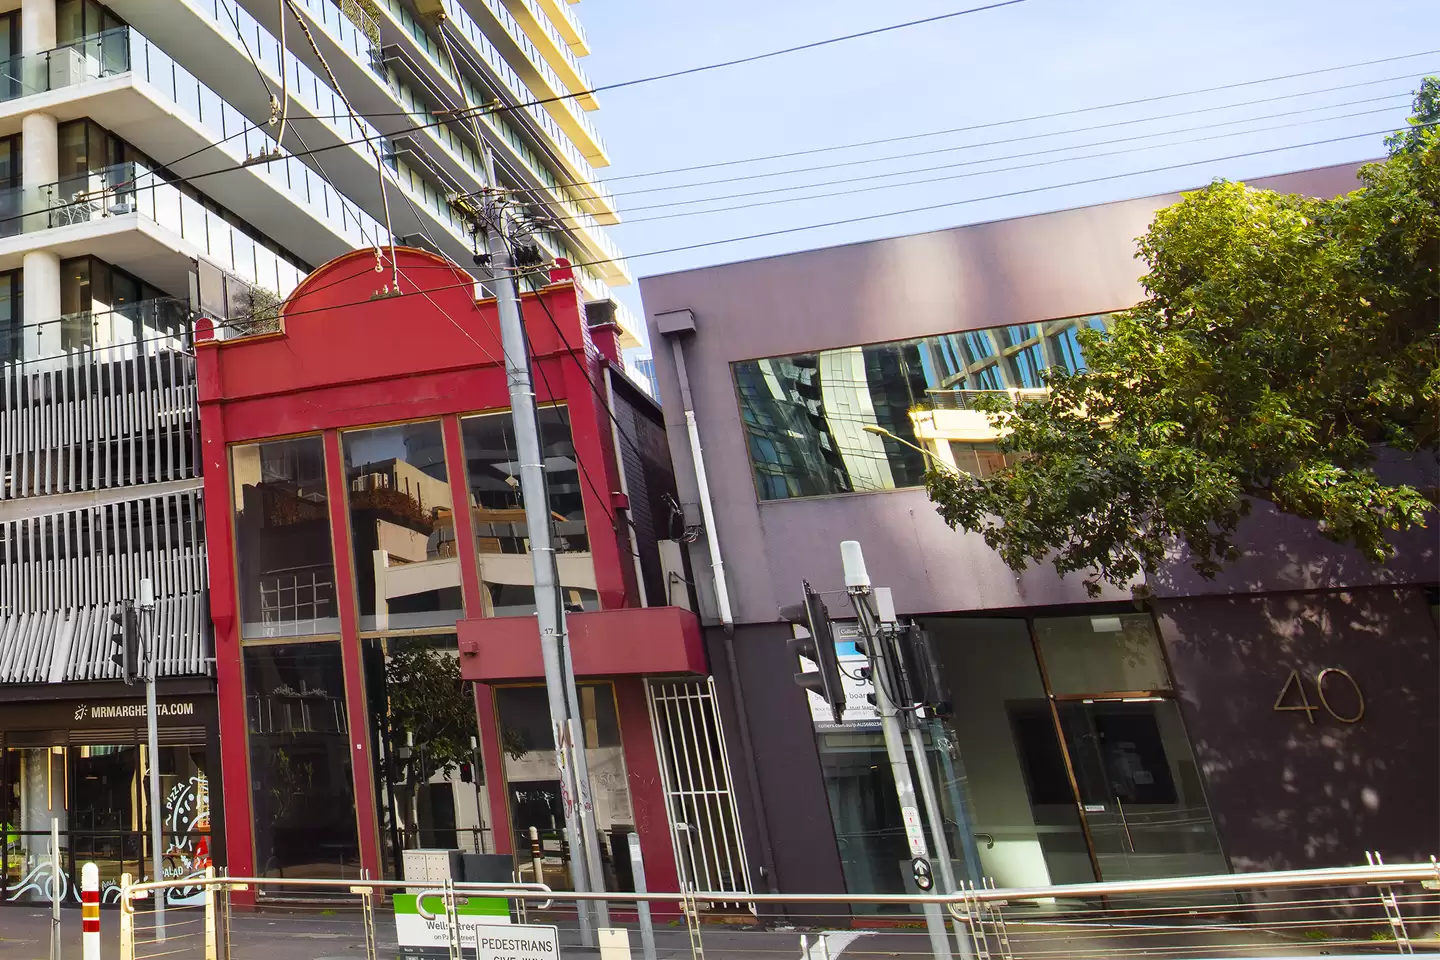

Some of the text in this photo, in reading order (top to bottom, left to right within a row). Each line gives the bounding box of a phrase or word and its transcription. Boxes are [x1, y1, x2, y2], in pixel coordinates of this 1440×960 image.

[1273, 668, 1365, 724] 40
[91, 703, 194, 718] MRMARGHETA.COM
[166, 782, 185, 810] PIZZA
[481, 938, 553, 953] PEDESTRIANS
